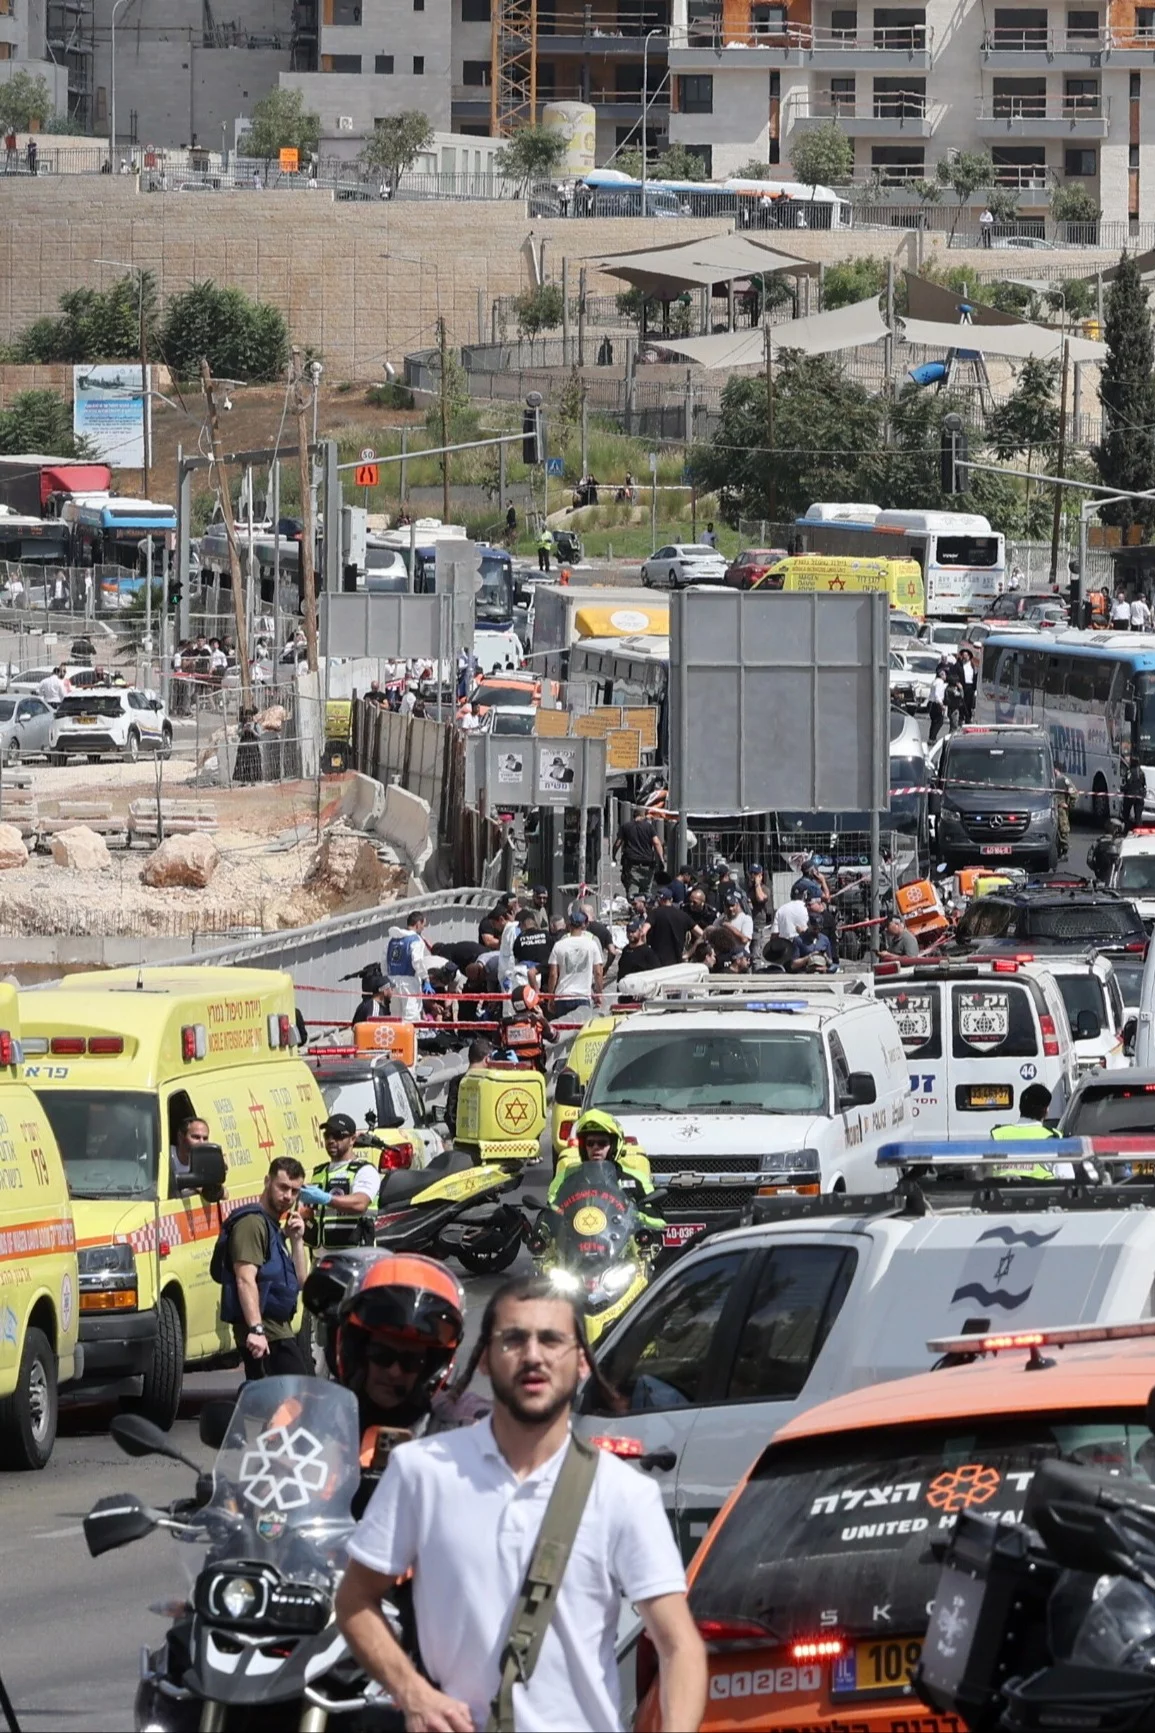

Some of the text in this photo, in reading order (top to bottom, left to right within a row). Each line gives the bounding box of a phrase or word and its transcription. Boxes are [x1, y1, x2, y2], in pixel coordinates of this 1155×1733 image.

[363, 451, 373, 459] 50
[521, 938, 547, 947] POLICE
[1020, 1065, 1036, 1078] 44
[810, 1481, 921, 1516] הצלה
[840, 1517, 928, 1541] UNITED
[734, 1669, 814, 1692] 1221
